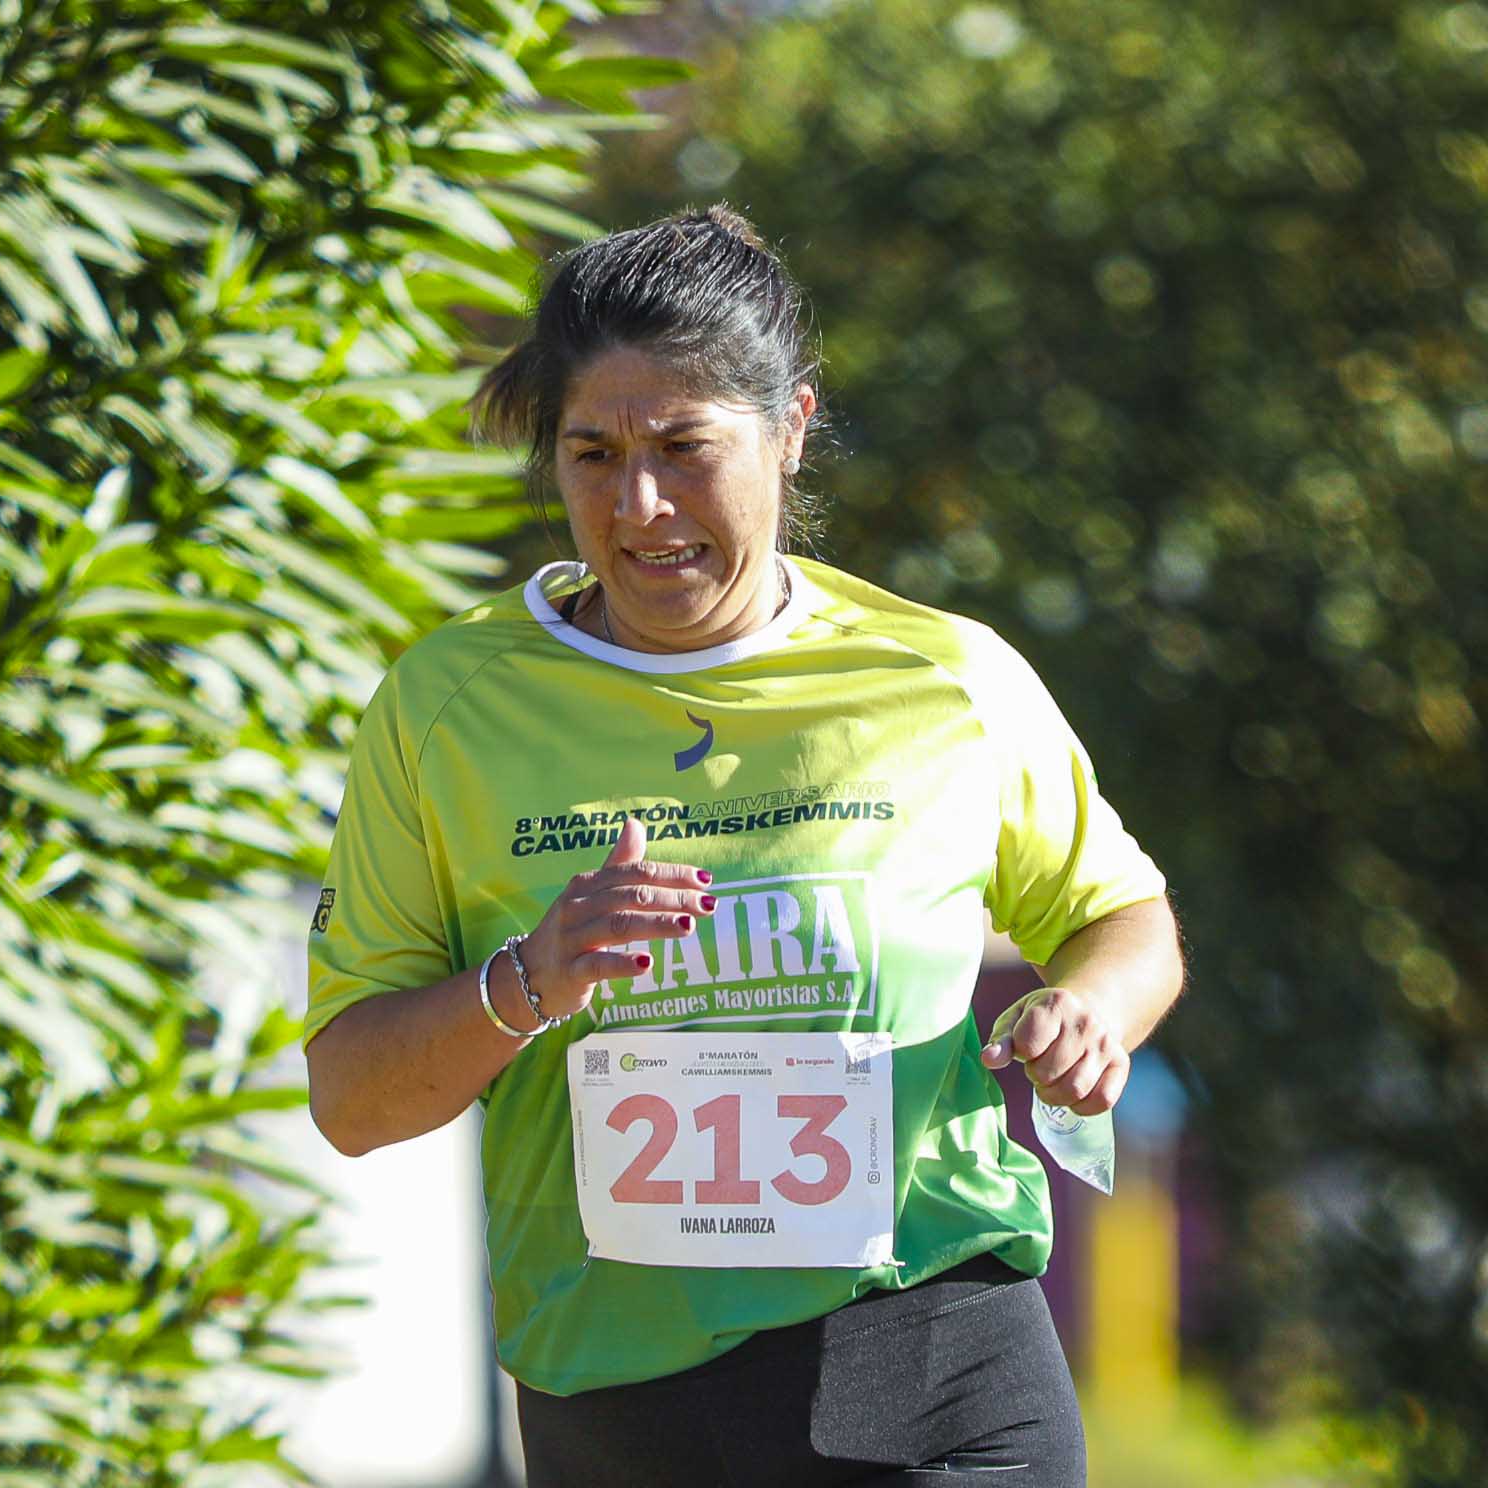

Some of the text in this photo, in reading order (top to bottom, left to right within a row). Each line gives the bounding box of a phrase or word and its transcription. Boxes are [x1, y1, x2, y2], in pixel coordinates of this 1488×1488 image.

[511, 801, 895, 857] CAWILIAMSKEMMIS
[715, 981, 820, 1011] Mayoristas
[605, 1093, 852, 1206] 213
[679, 1216, 776, 1234] IVANA LARROZA
